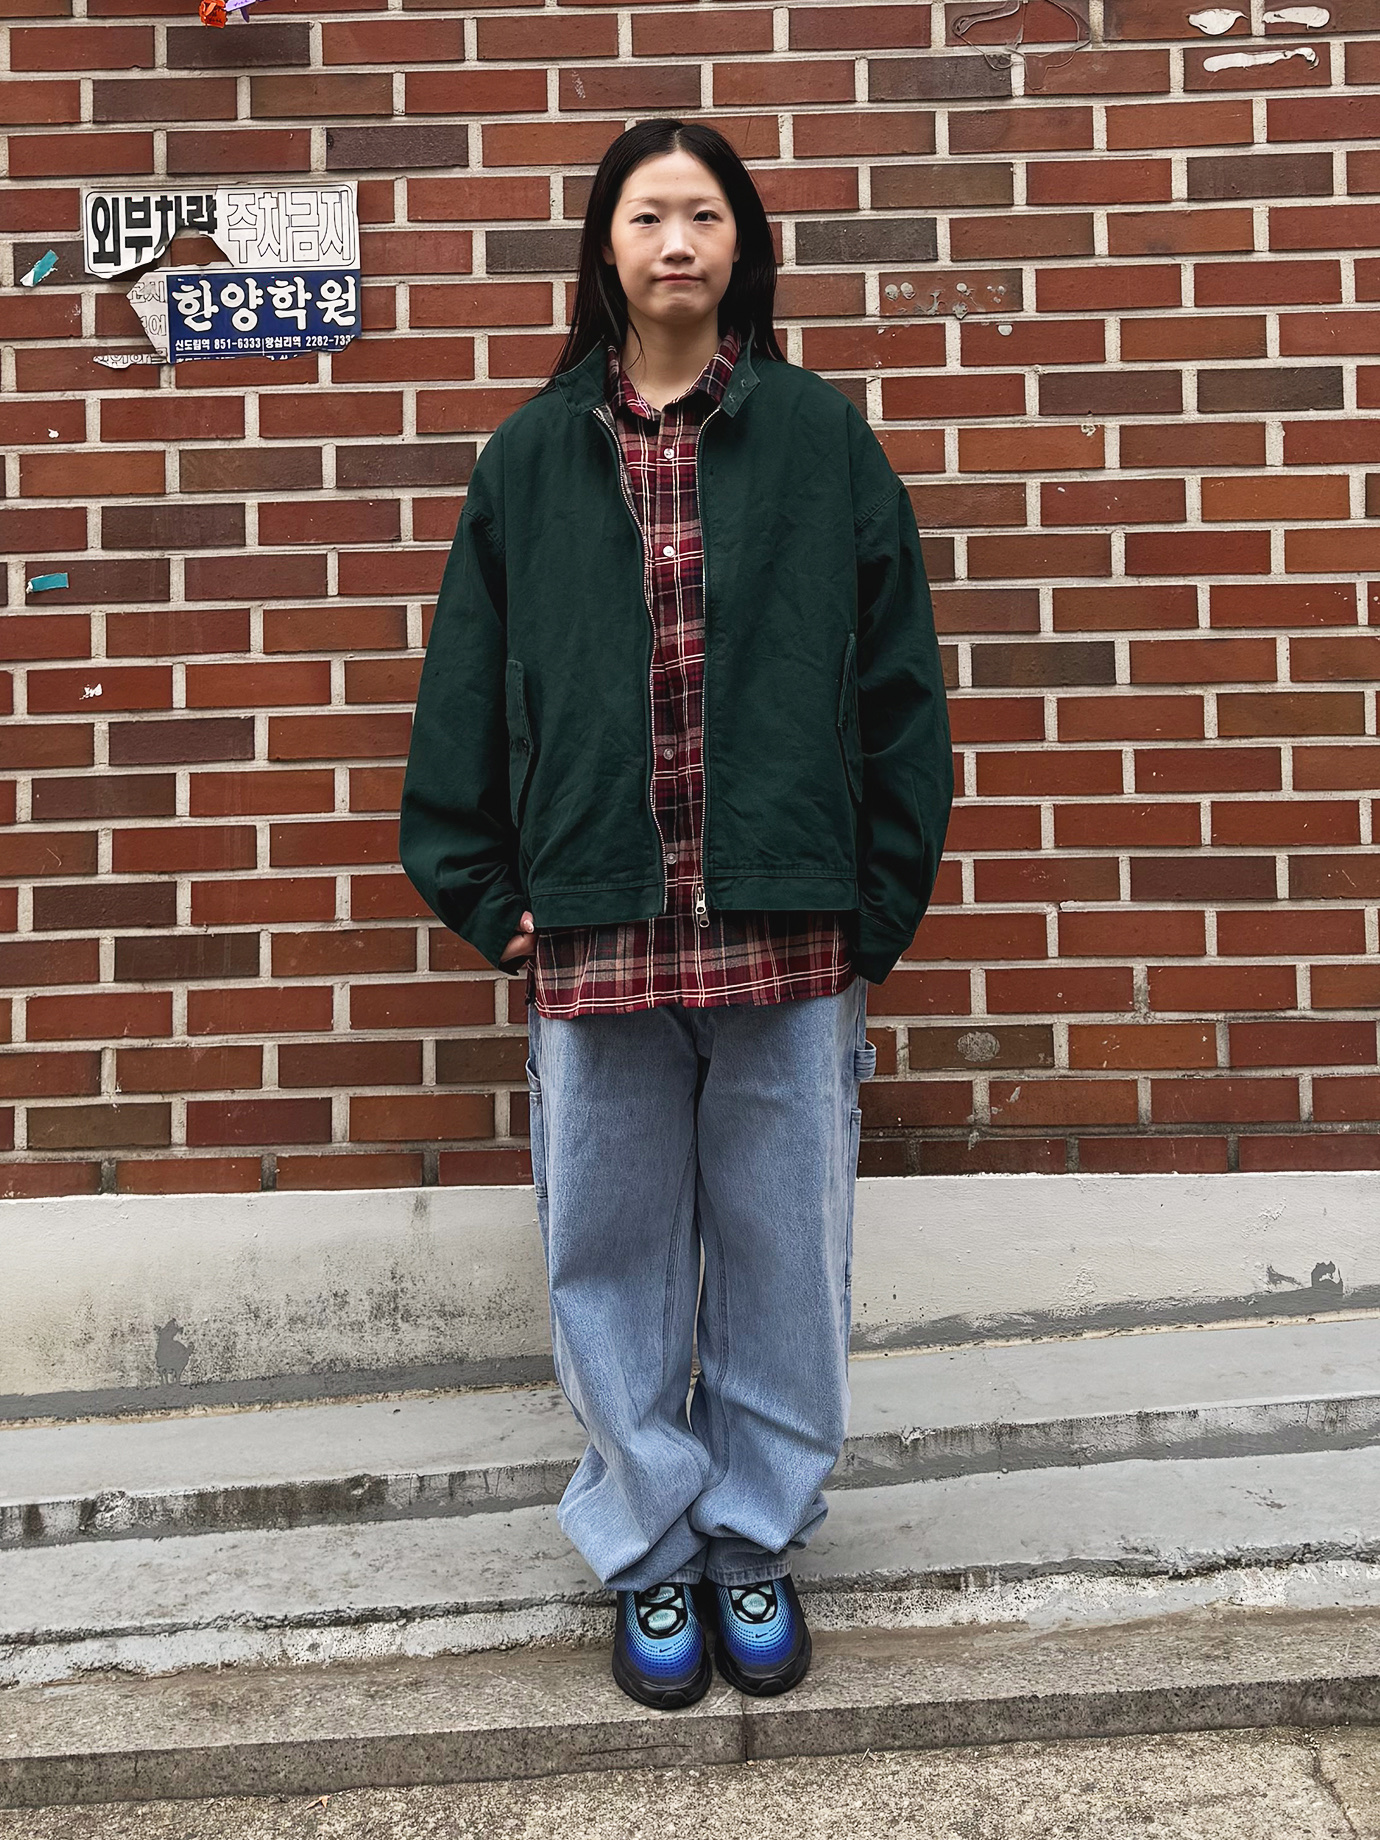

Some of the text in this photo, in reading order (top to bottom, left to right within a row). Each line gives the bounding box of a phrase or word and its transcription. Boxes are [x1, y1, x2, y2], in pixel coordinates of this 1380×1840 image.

[227, 190, 352, 264] 주차금지
[171, 275, 356, 333] 한양학원
[214, 337, 261, 350] 851-6333
[265, 335, 302, 349] 왕십리역
[306, 334, 356, 347] 2282-733
